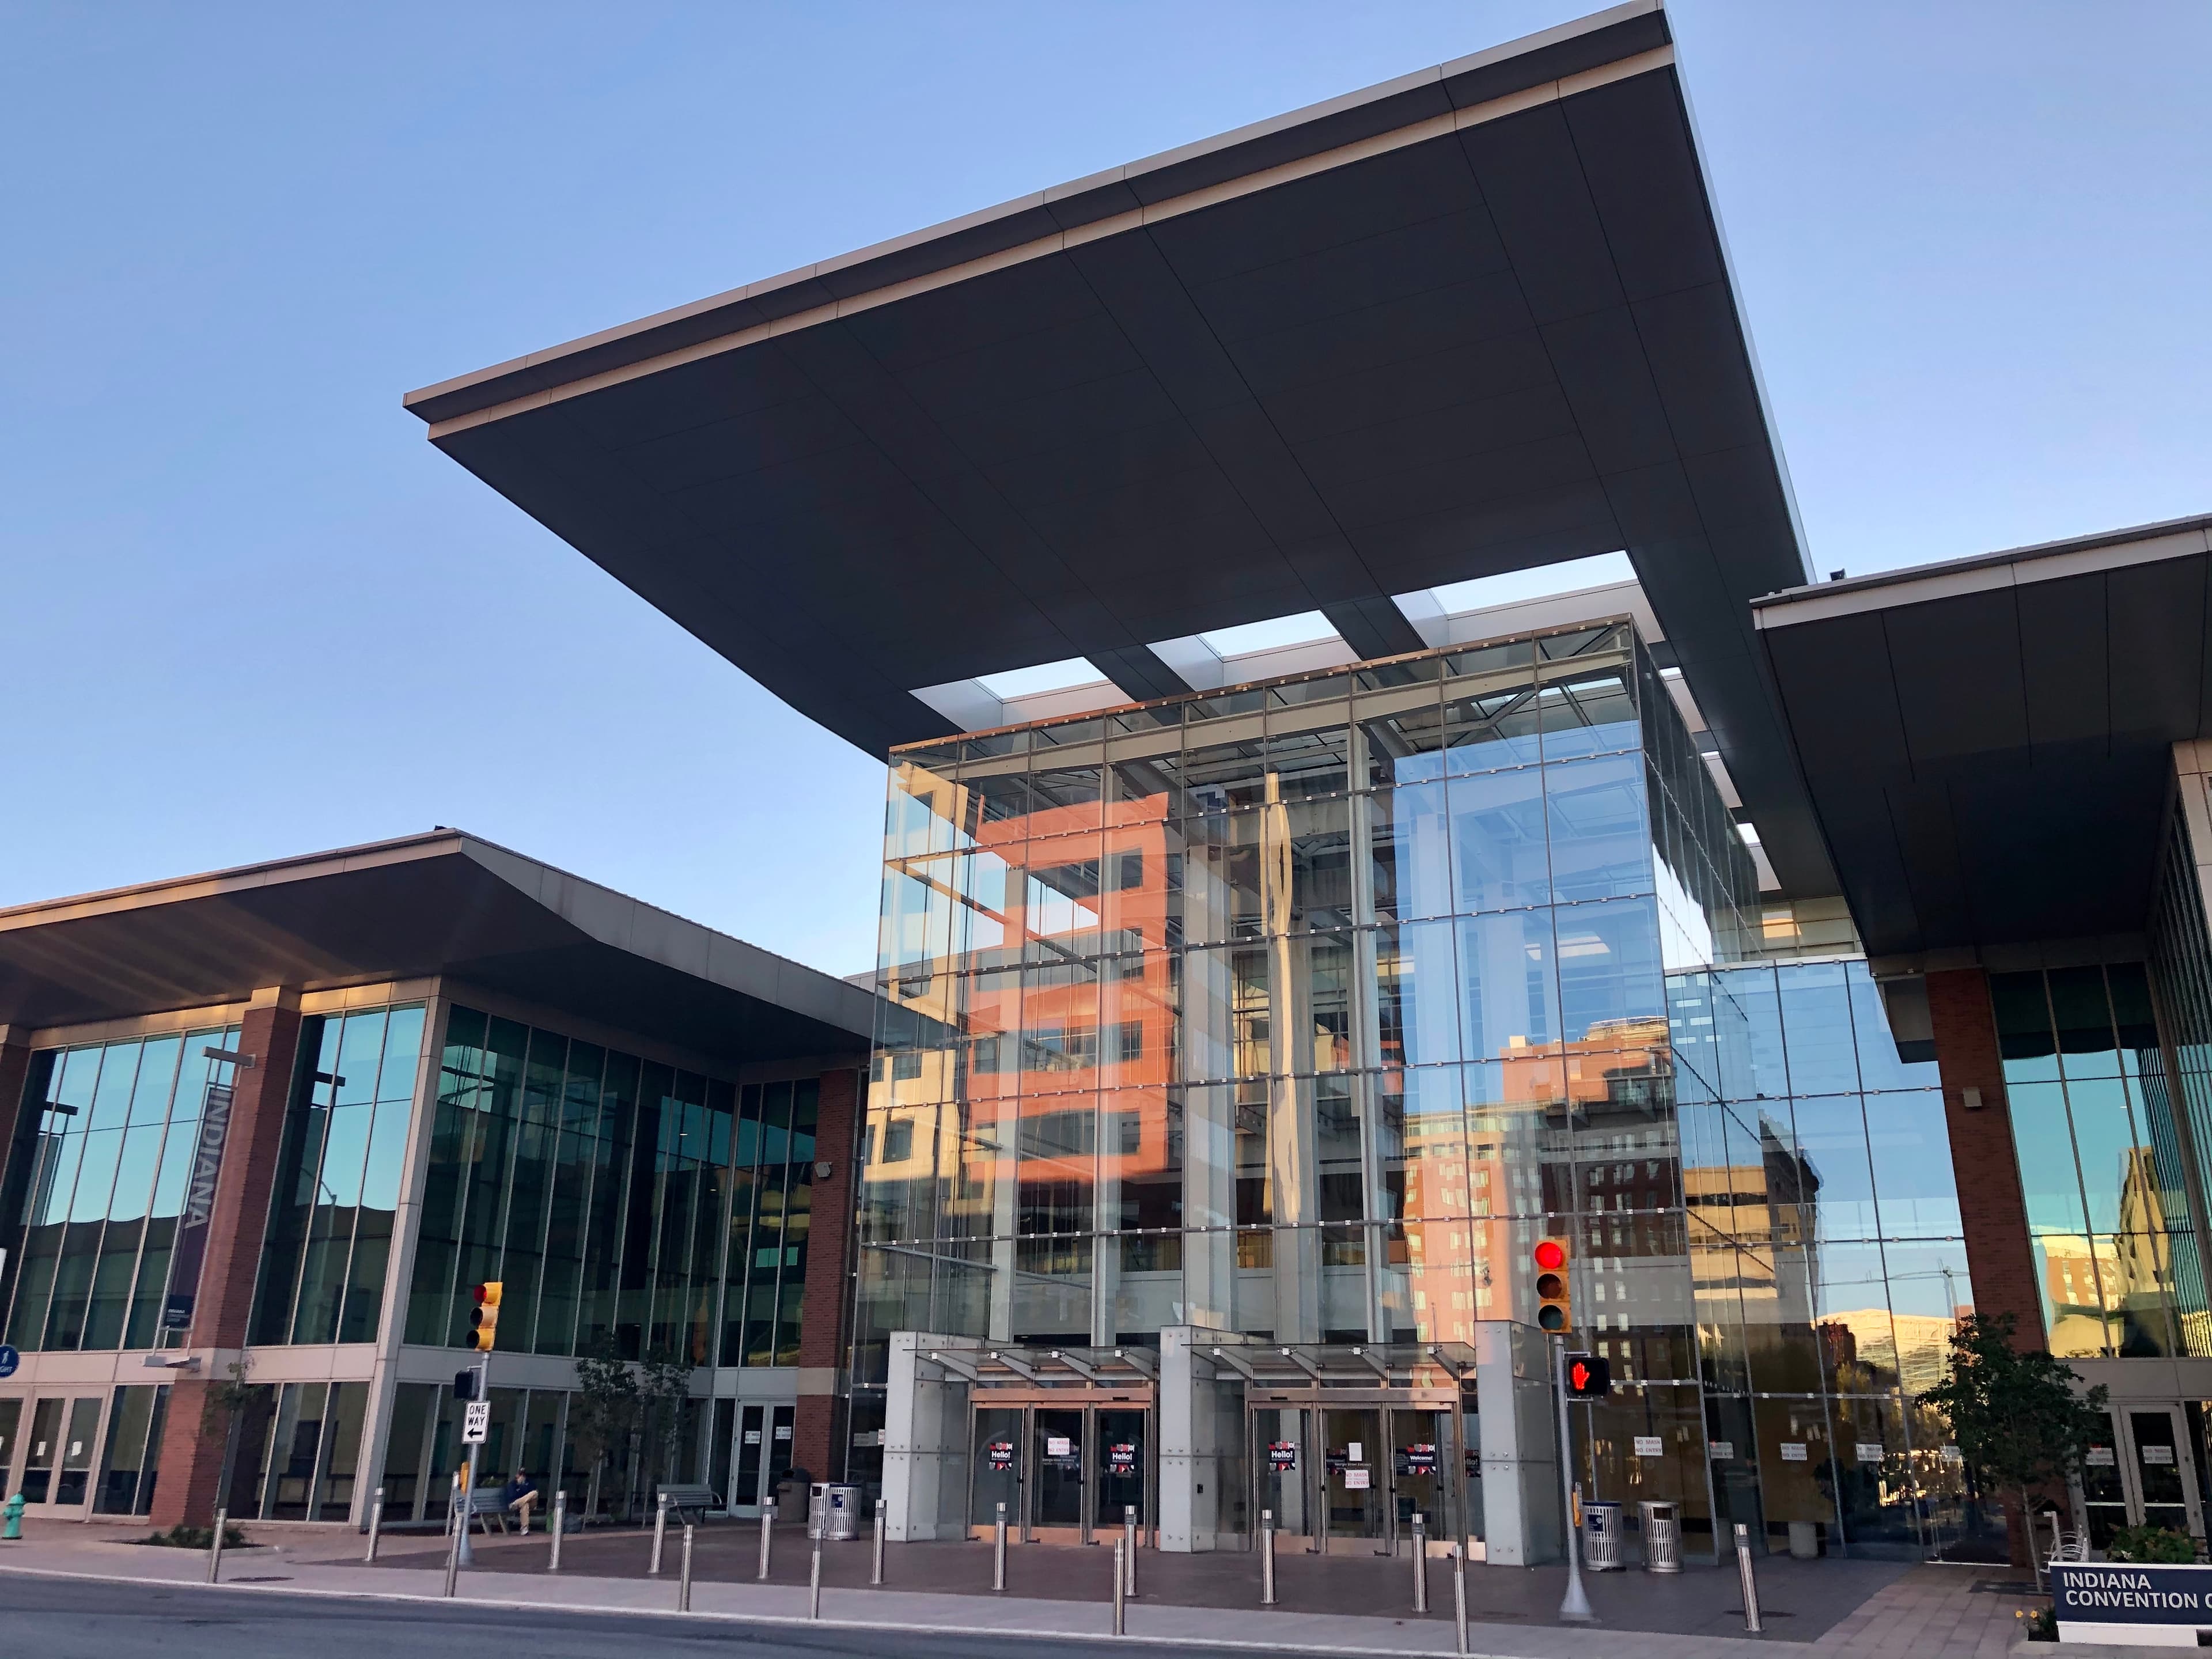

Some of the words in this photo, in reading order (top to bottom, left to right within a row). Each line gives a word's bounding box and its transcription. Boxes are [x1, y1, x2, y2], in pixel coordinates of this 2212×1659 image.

[184, 1089, 231, 1229] INDIANA
[469, 1405, 486, 1415] ONE
[468, 1416, 485, 1426] WAY
[991, 1450, 1010, 1459] Hello!
[1112, 1452, 1132, 1460] Hello!
[2063, 1572, 2152, 1590] INDIANA
[2066, 1590, 2198, 1608] CONVENTION
